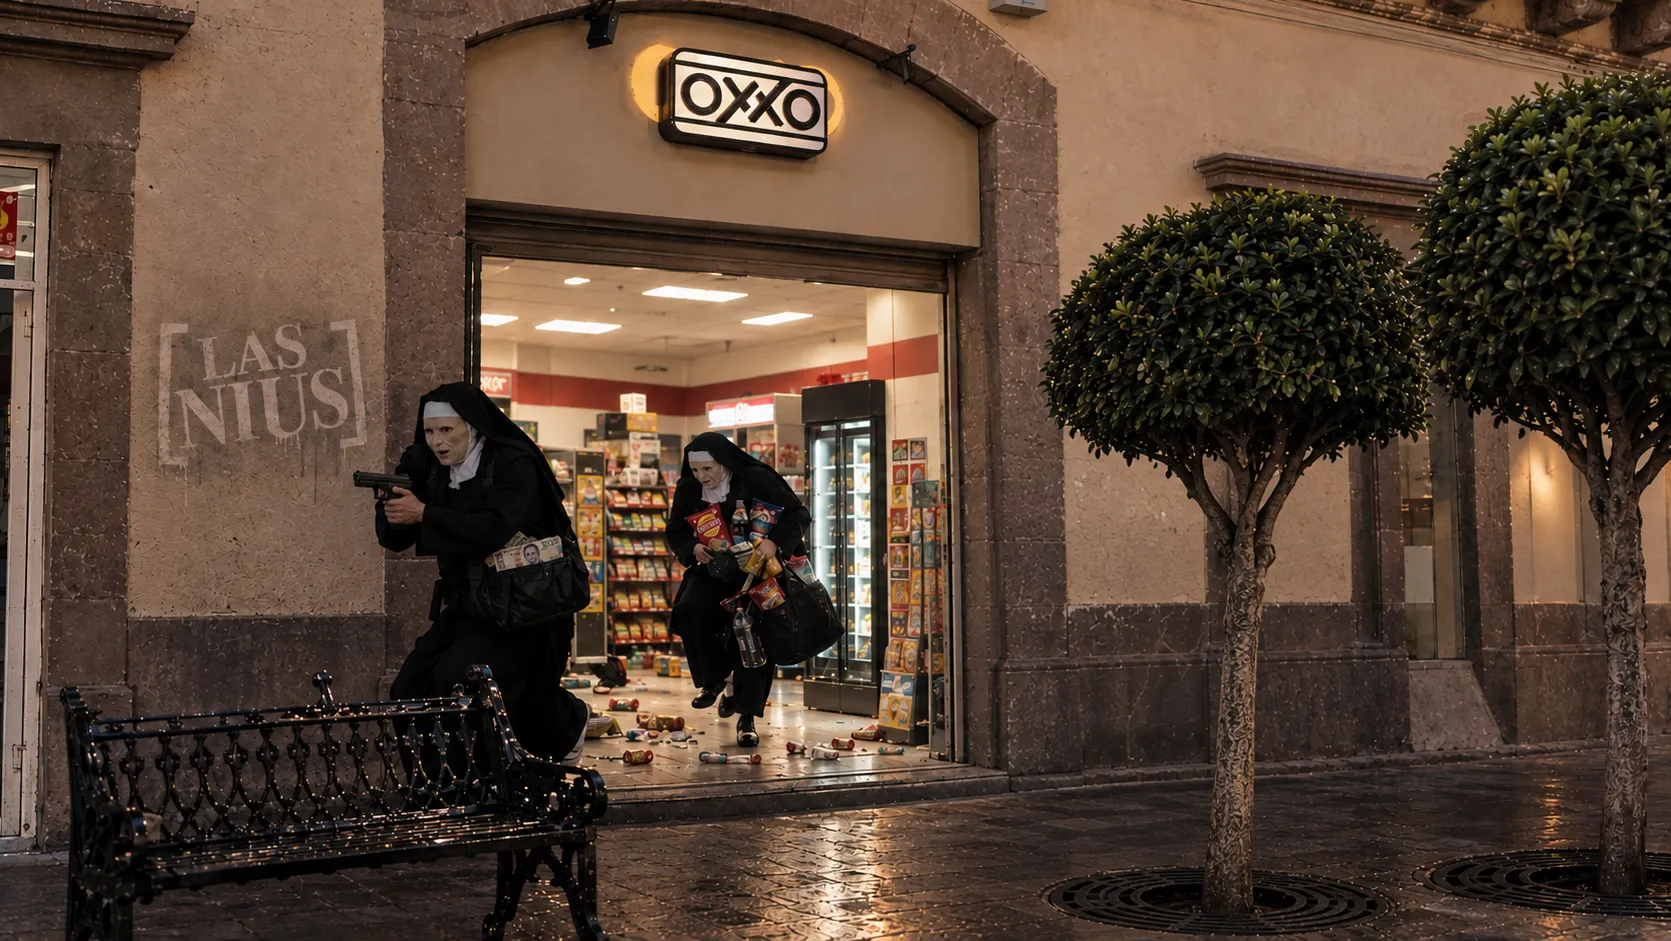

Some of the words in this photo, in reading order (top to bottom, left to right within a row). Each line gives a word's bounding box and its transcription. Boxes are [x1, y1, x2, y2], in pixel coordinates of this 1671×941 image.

[680, 72, 821, 131] OXXO
[197, 323, 308, 381] LAS
[174, 366, 350, 450] NIUS
